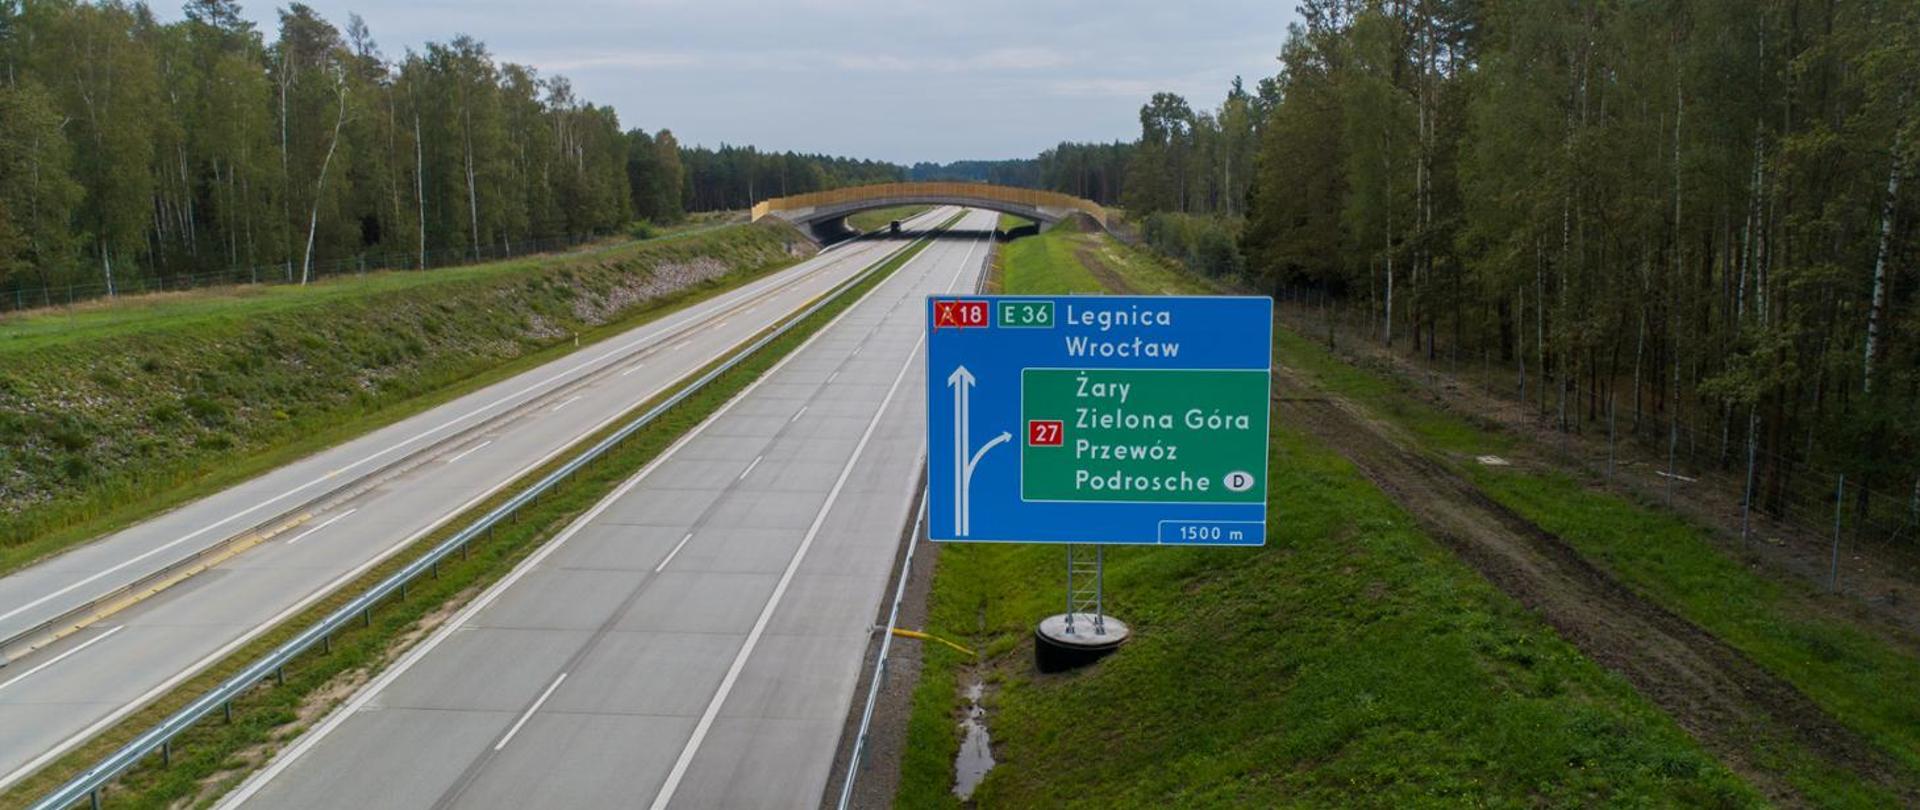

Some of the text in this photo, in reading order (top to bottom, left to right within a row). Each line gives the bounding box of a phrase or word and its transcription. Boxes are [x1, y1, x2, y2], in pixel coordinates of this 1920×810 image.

[1005, 305, 1048, 323] E 36
[1067, 305, 1171, 331] Legnica
[1066, 336, 1179, 357] Wrocław
[1076, 371, 1131, 402] Żary
[1076, 408, 1249, 429] Zielona Góra
[1035, 425, 1059, 442] 27
[1076, 439, 1177, 461] Przewóz
[1076, 470, 1210, 491] Podrosche
[1233, 474, 1245, 488] D
[1180, 526, 1243, 540] 1500 m
